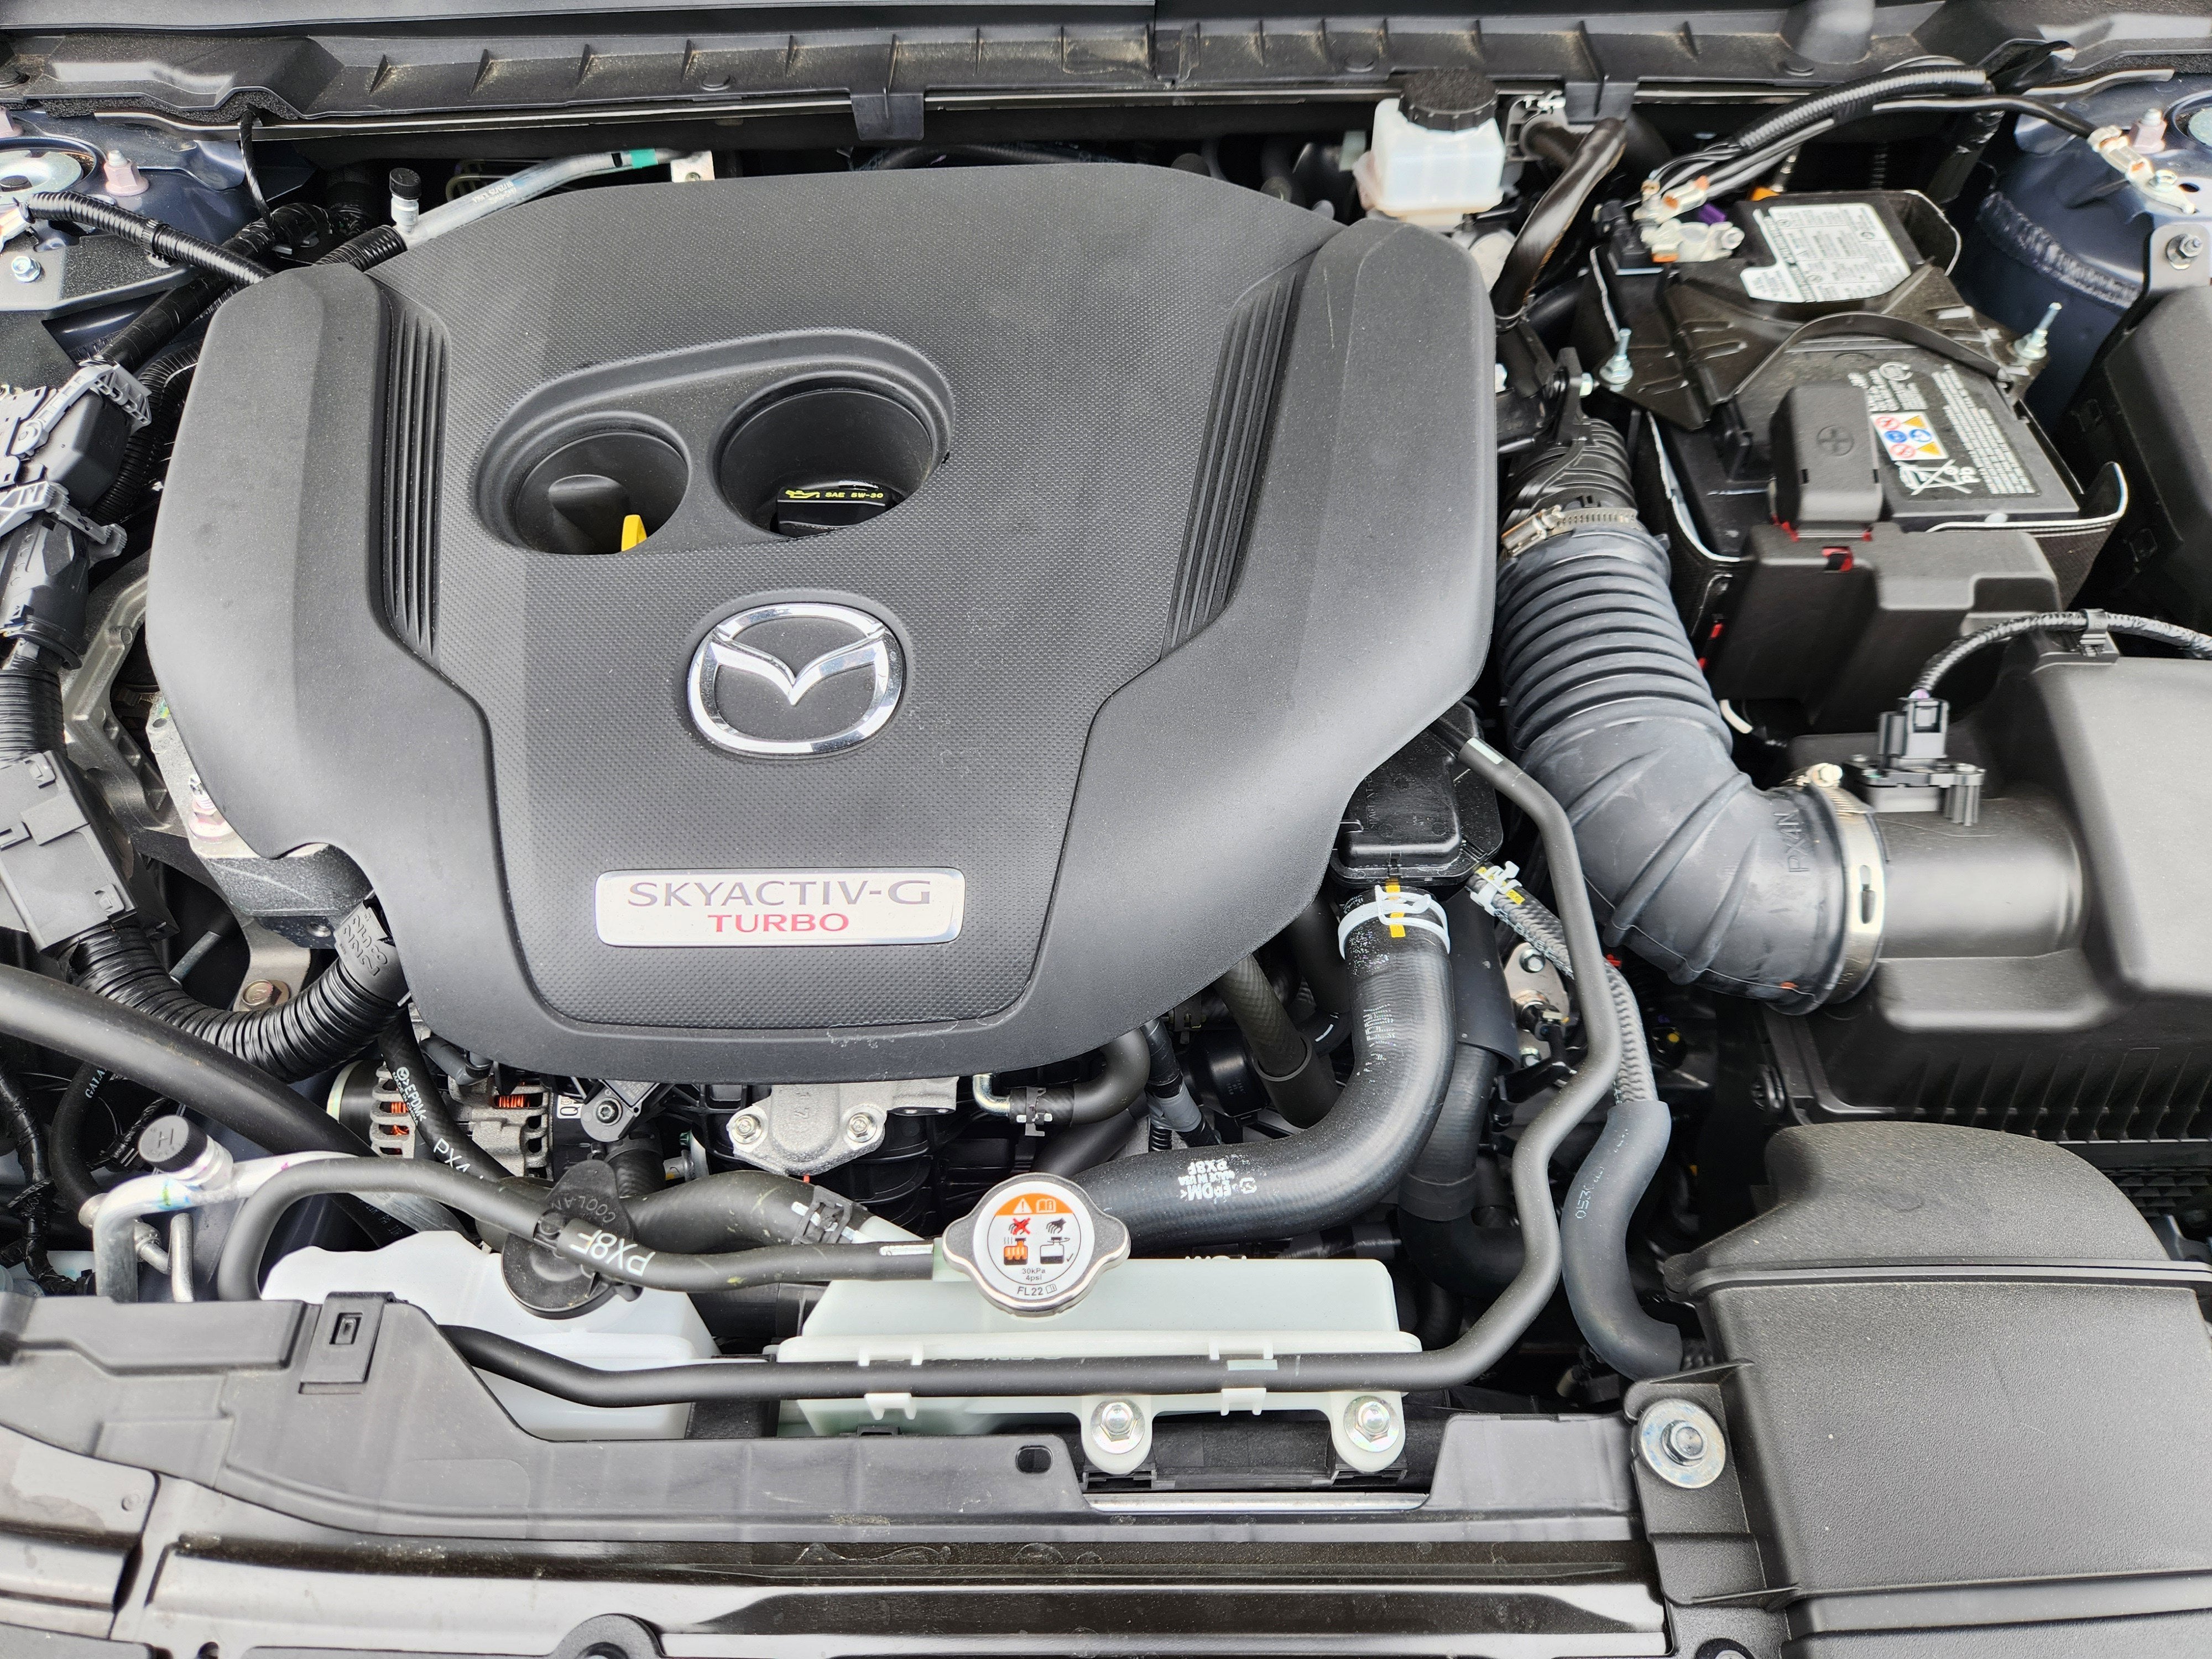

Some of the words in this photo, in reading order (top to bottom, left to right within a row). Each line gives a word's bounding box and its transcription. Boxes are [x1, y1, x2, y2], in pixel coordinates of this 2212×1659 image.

[1773, 809, 1810, 872] PX4N
[628, 880, 930, 907] SKYACTIV-G
[708, 913, 849, 933] TURBO
[392, 1071, 404, 1094] MADE
[406, 1102, 419, 1126] CHINA
[551, 1196, 615, 1223] COOLAN
[569, 1229, 656, 1277] PX8F
[1018, 1286, 1044, 1296] FL22
